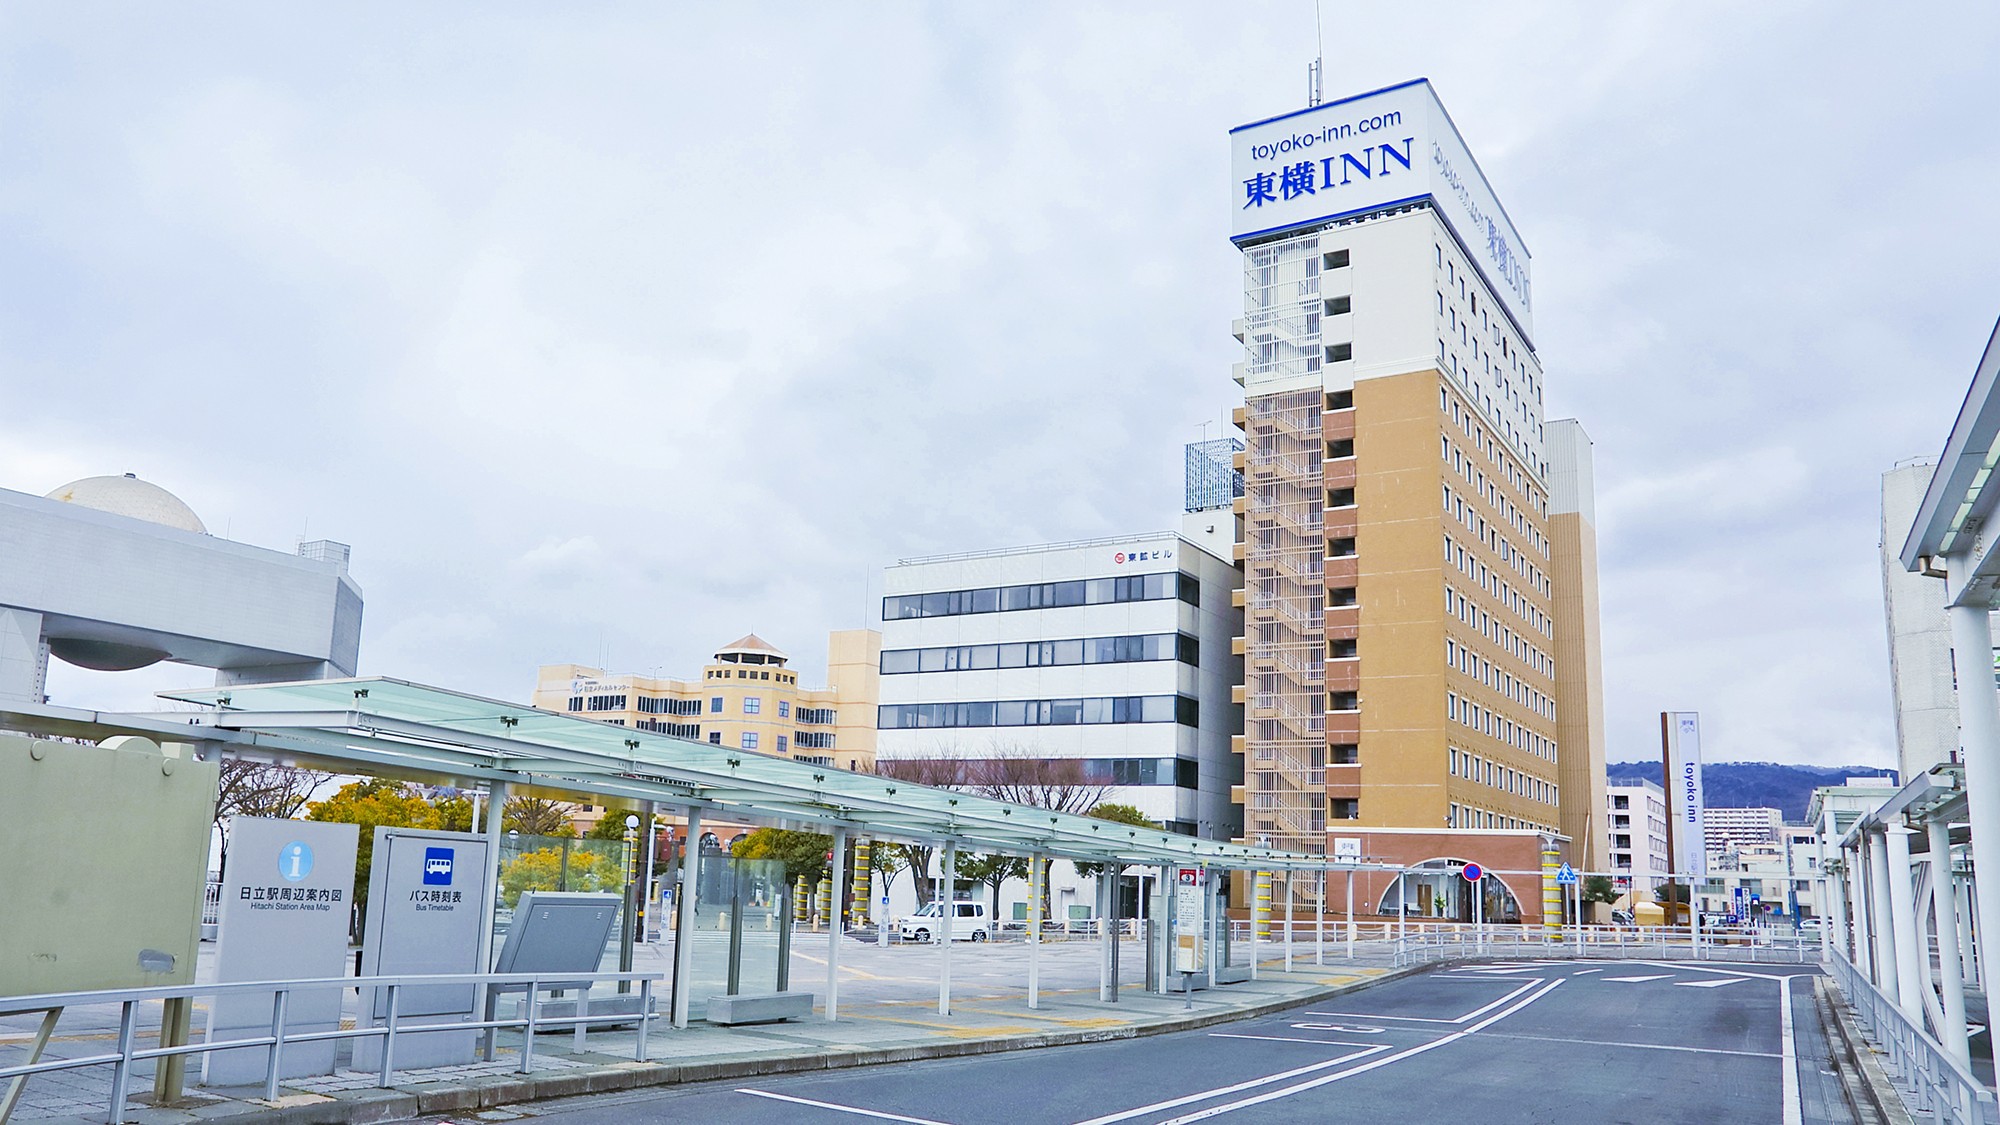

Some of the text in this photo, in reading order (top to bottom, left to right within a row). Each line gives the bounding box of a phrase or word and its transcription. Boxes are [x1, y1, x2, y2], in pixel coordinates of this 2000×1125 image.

[1251, 108, 1402, 160] toyoko-inn.com
[1242, 137, 1414, 210] 東横INN
[1684, 762, 1697, 822] toyoko inn
[240, 886, 342, 902] 日立駅周辺案内図
[409, 890, 462, 903] バス時刻表
[251, 902, 330, 912] Hitachi Station Area Map
[415, 903, 427, 911] Bus
[1728, 915, 1736, 923] P
